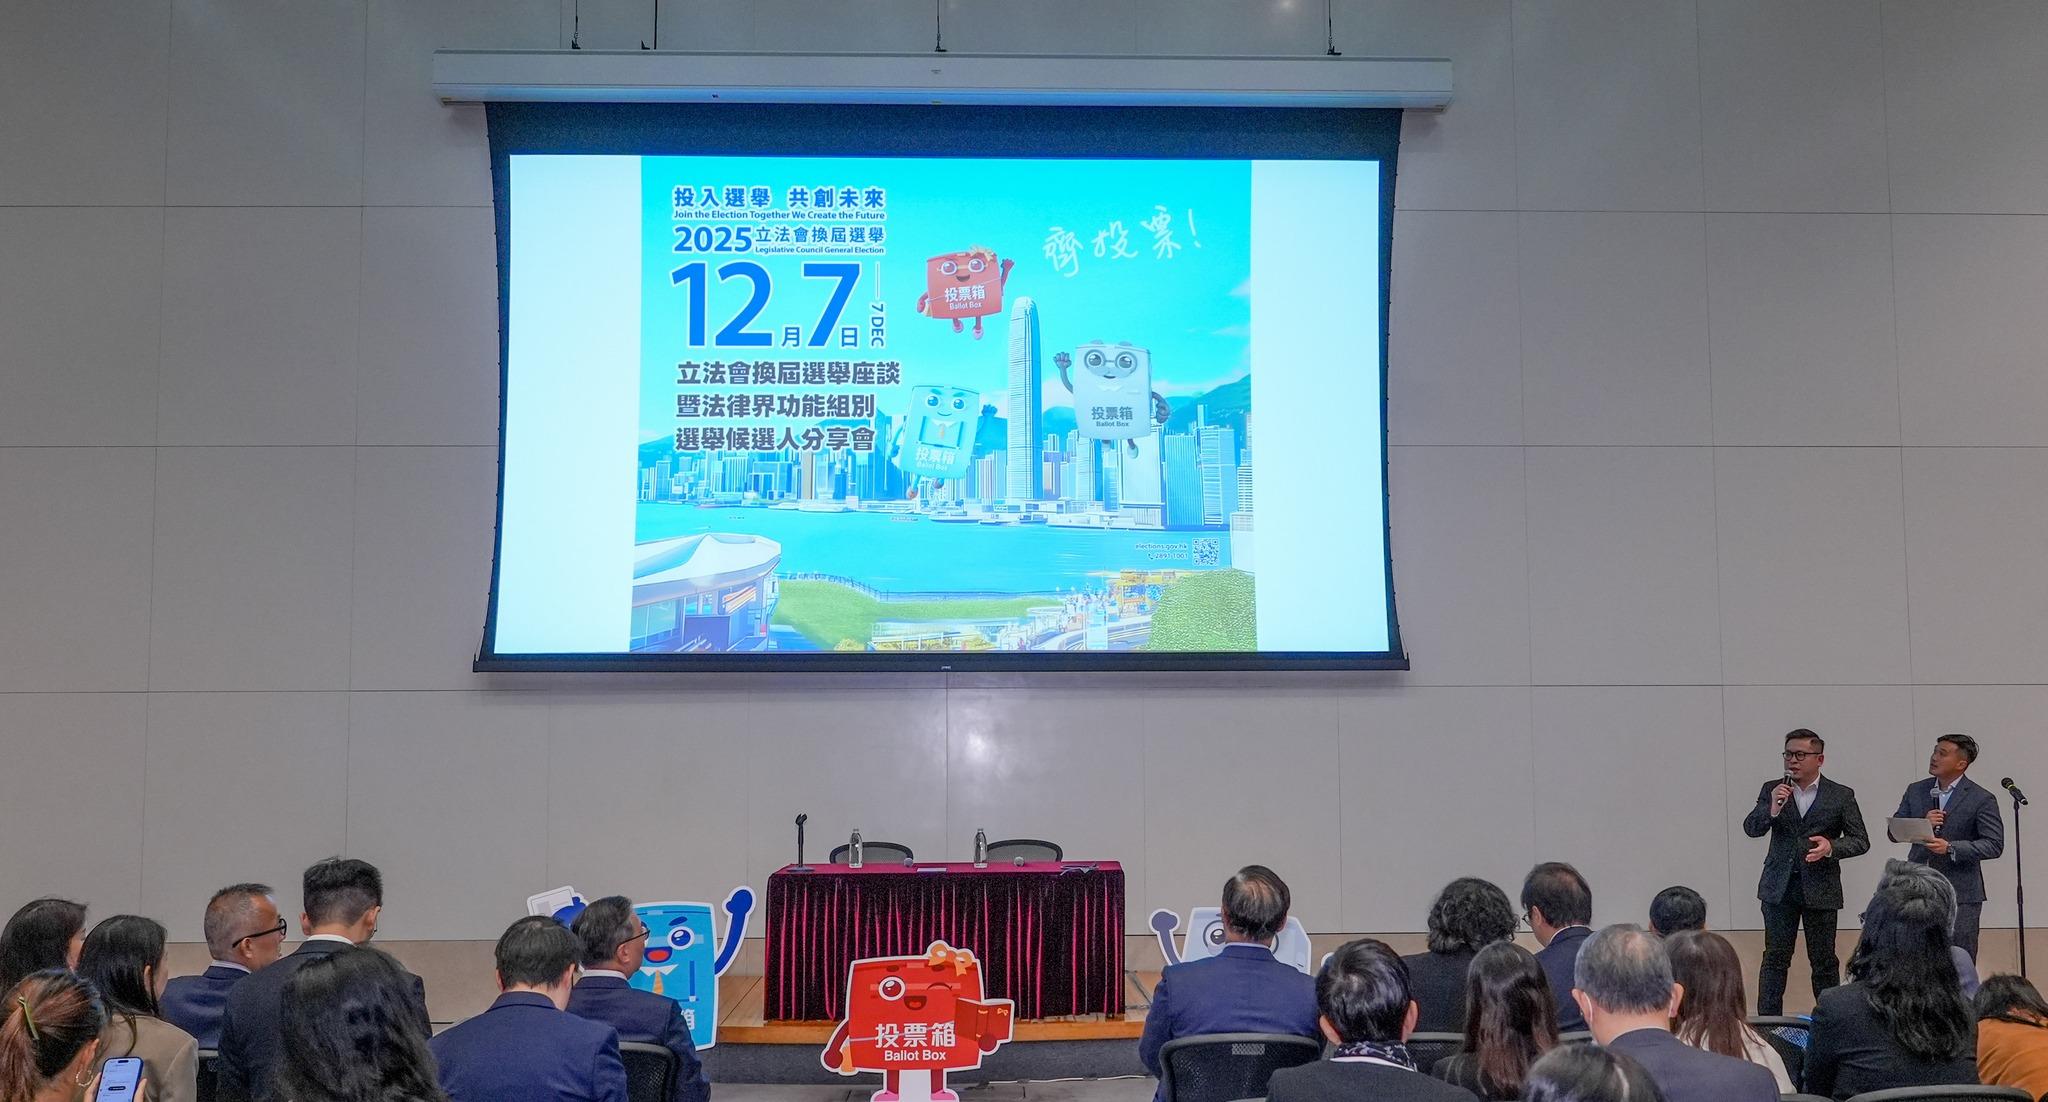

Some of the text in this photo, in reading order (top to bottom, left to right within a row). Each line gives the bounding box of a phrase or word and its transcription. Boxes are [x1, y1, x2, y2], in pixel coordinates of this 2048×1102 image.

[674, 187, 884, 208] 投入選舉 共創未來
[674, 210, 693, 219] Join
[695, 210, 710, 219] the
[712, 210, 748, 219] Election
[750, 210, 790, 220] Together
[792, 211, 806, 219] We
[808, 211, 837, 219] Create
[839, 211, 854, 219] the
[674, 226, 884, 252] 2025 立法會換屆選舉
[755, 246, 795, 254] Legislative
[944, 285, 985, 302] 投票箱
[949, 301, 982, 310] Ballot Box
[872, 304, 883, 347] 7 DEC
[677, 361, 900, 385] 立法會換屆選舉座談
[676, 394, 875, 418] 暨法律界功能組別
[1091, 406, 1133, 420] 投票箱
[676, 427, 876, 451] 選舉候選人分享會
[1135, 543, 1187, 551] elections.gov.hk
[875, 1021, 956, 1048] 投票箱
[884, 1049, 946, 1061] Ballot Box
